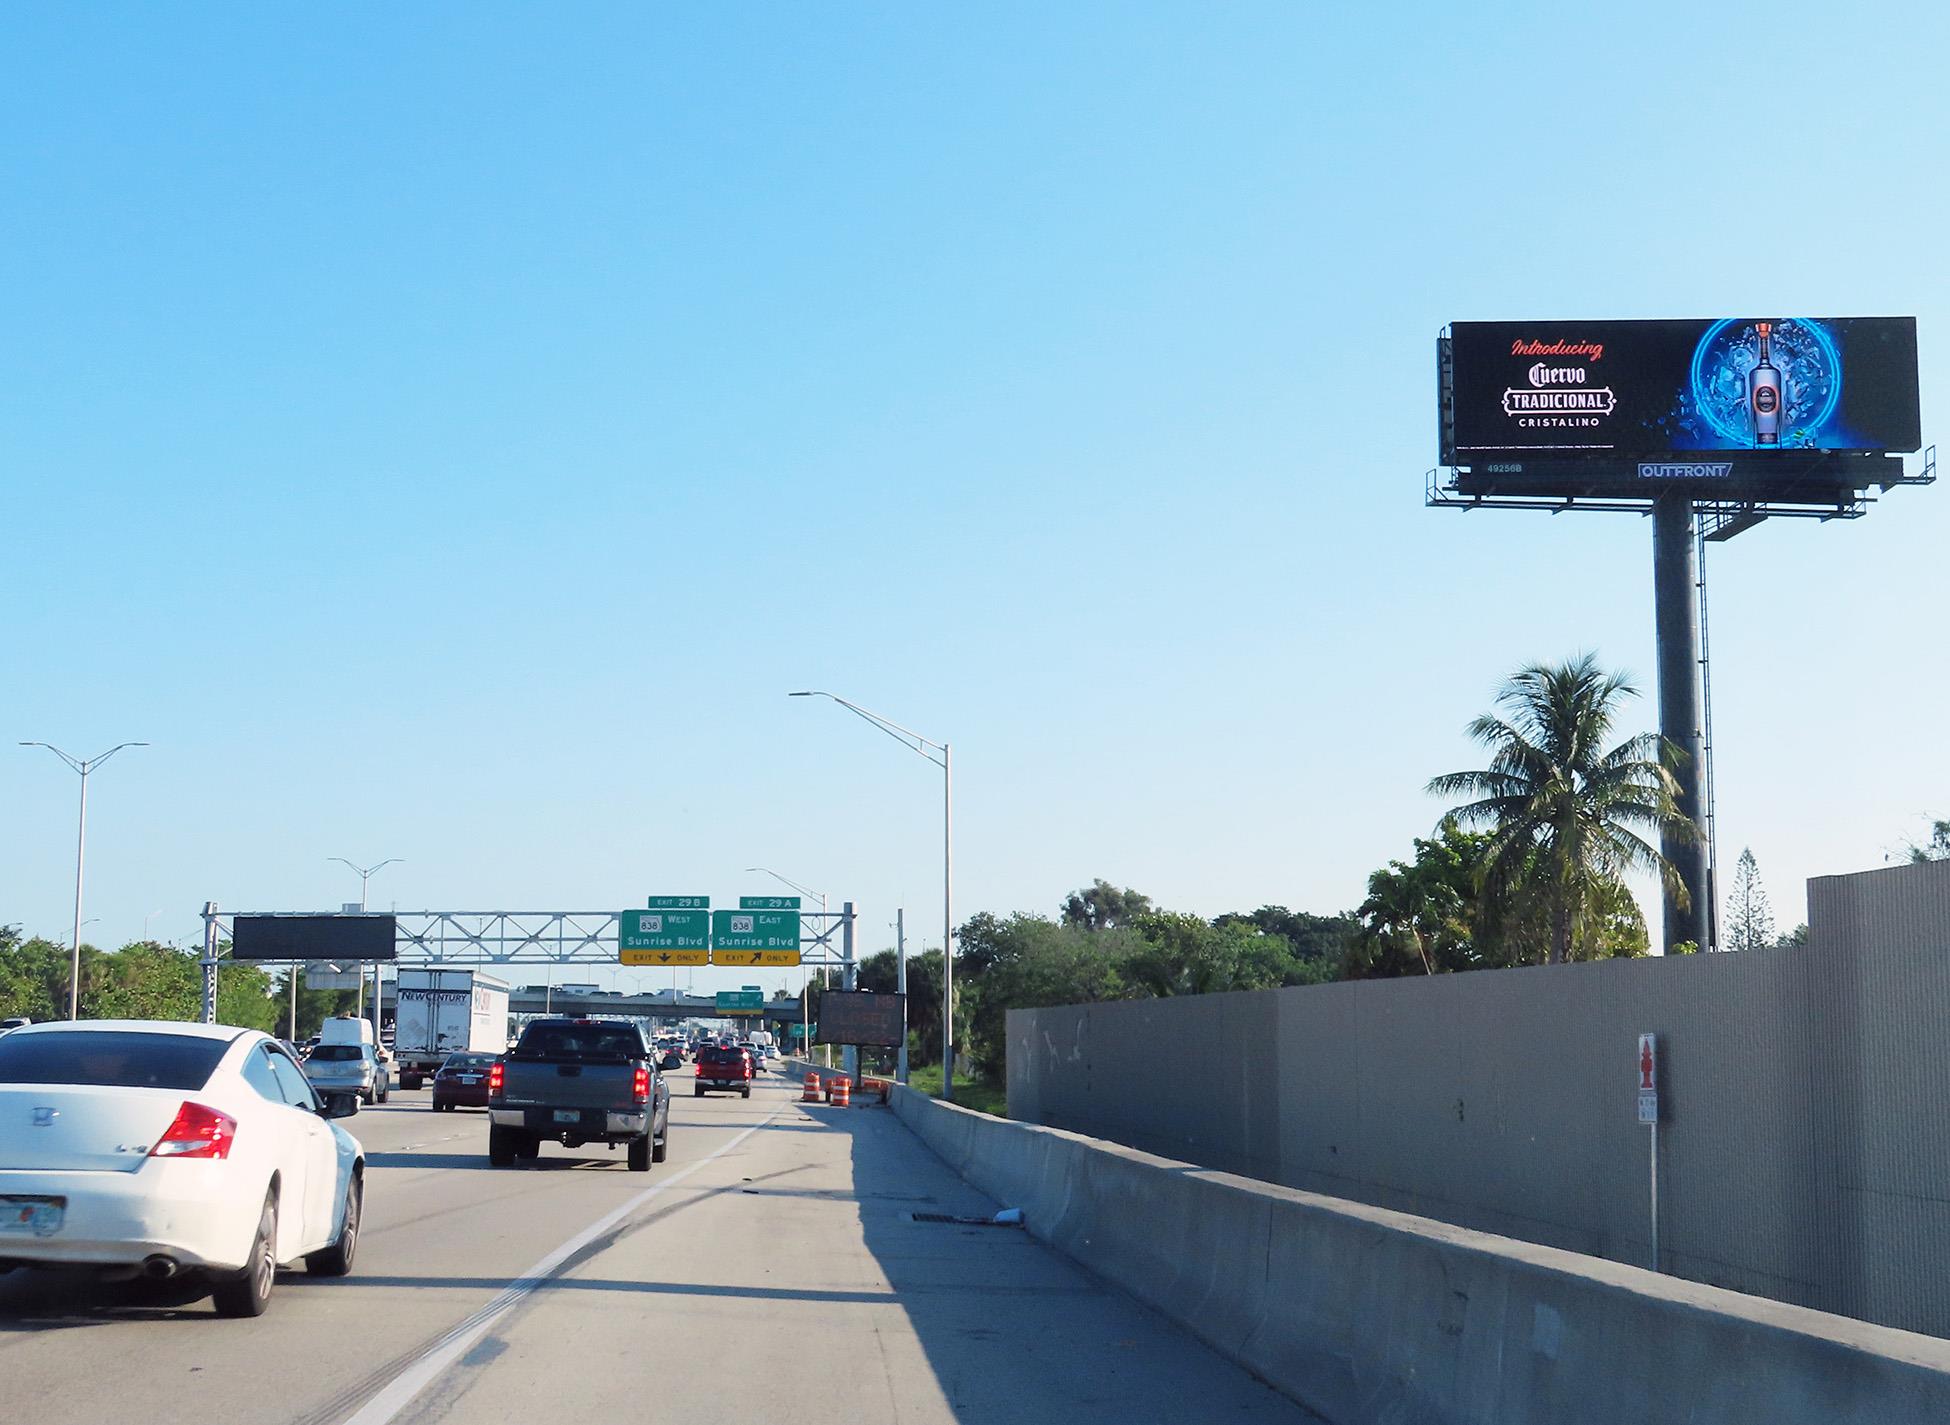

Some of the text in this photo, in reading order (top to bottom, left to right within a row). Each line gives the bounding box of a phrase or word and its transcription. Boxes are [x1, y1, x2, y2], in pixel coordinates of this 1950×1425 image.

[1511, 338, 1604, 362] Introducing
[1528, 361, 1587, 388] Cuervo
[1512, 393, 1604, 409] TRADICIONAL
[1518, 417, 1600, 428] CRISTALINO
[1641, 465, 1728, 478] OUTFRONT
[667, 914, 691, 924] WEST
[759, 915, 782, 924] EAST
[640, 921, 659, 930] 838
[732, 922, 750, 931] 838
[627, 936, 704, 946] Sunrise Blvd
[718, 936, 794, 946] Sunrise Blvd
